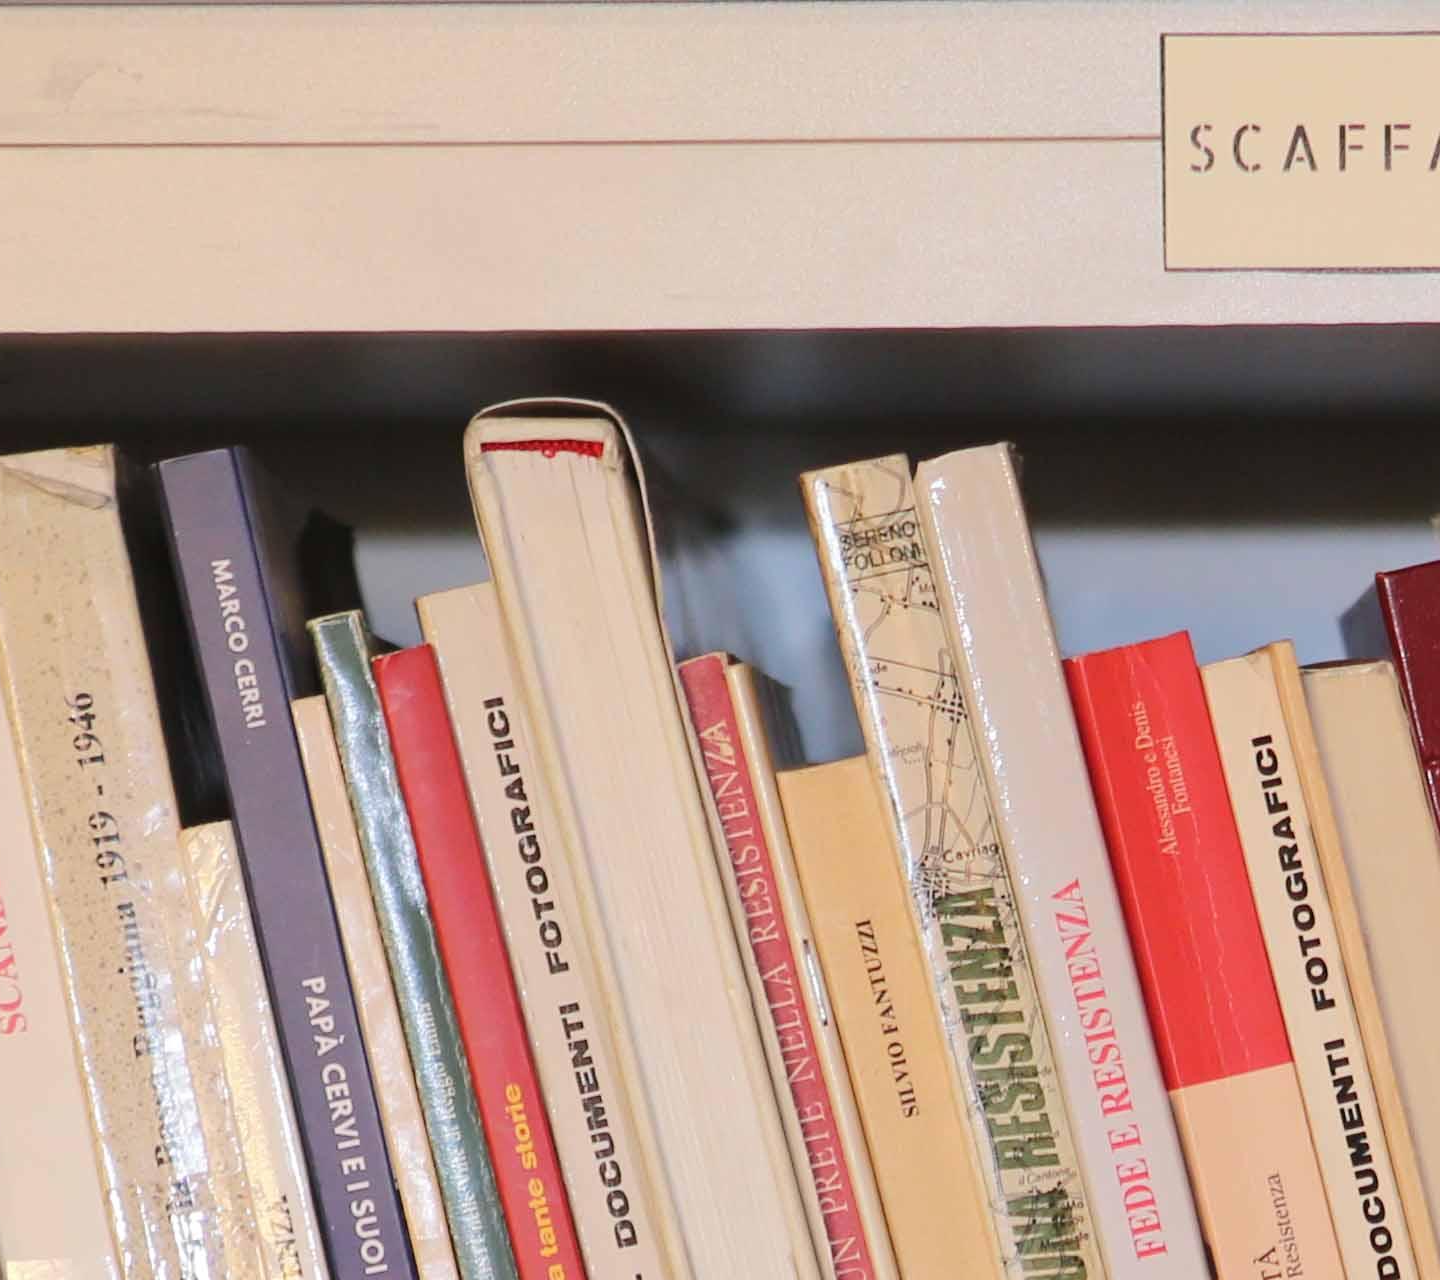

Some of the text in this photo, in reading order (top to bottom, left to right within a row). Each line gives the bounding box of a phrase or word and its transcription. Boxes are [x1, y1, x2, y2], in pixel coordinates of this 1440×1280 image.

[1253, 734, 1338, 1011] FOTOGRAFICI
[303, 976, 345, 1055] PAPÀ
[349, 1199, 384, 1274] SUOI
